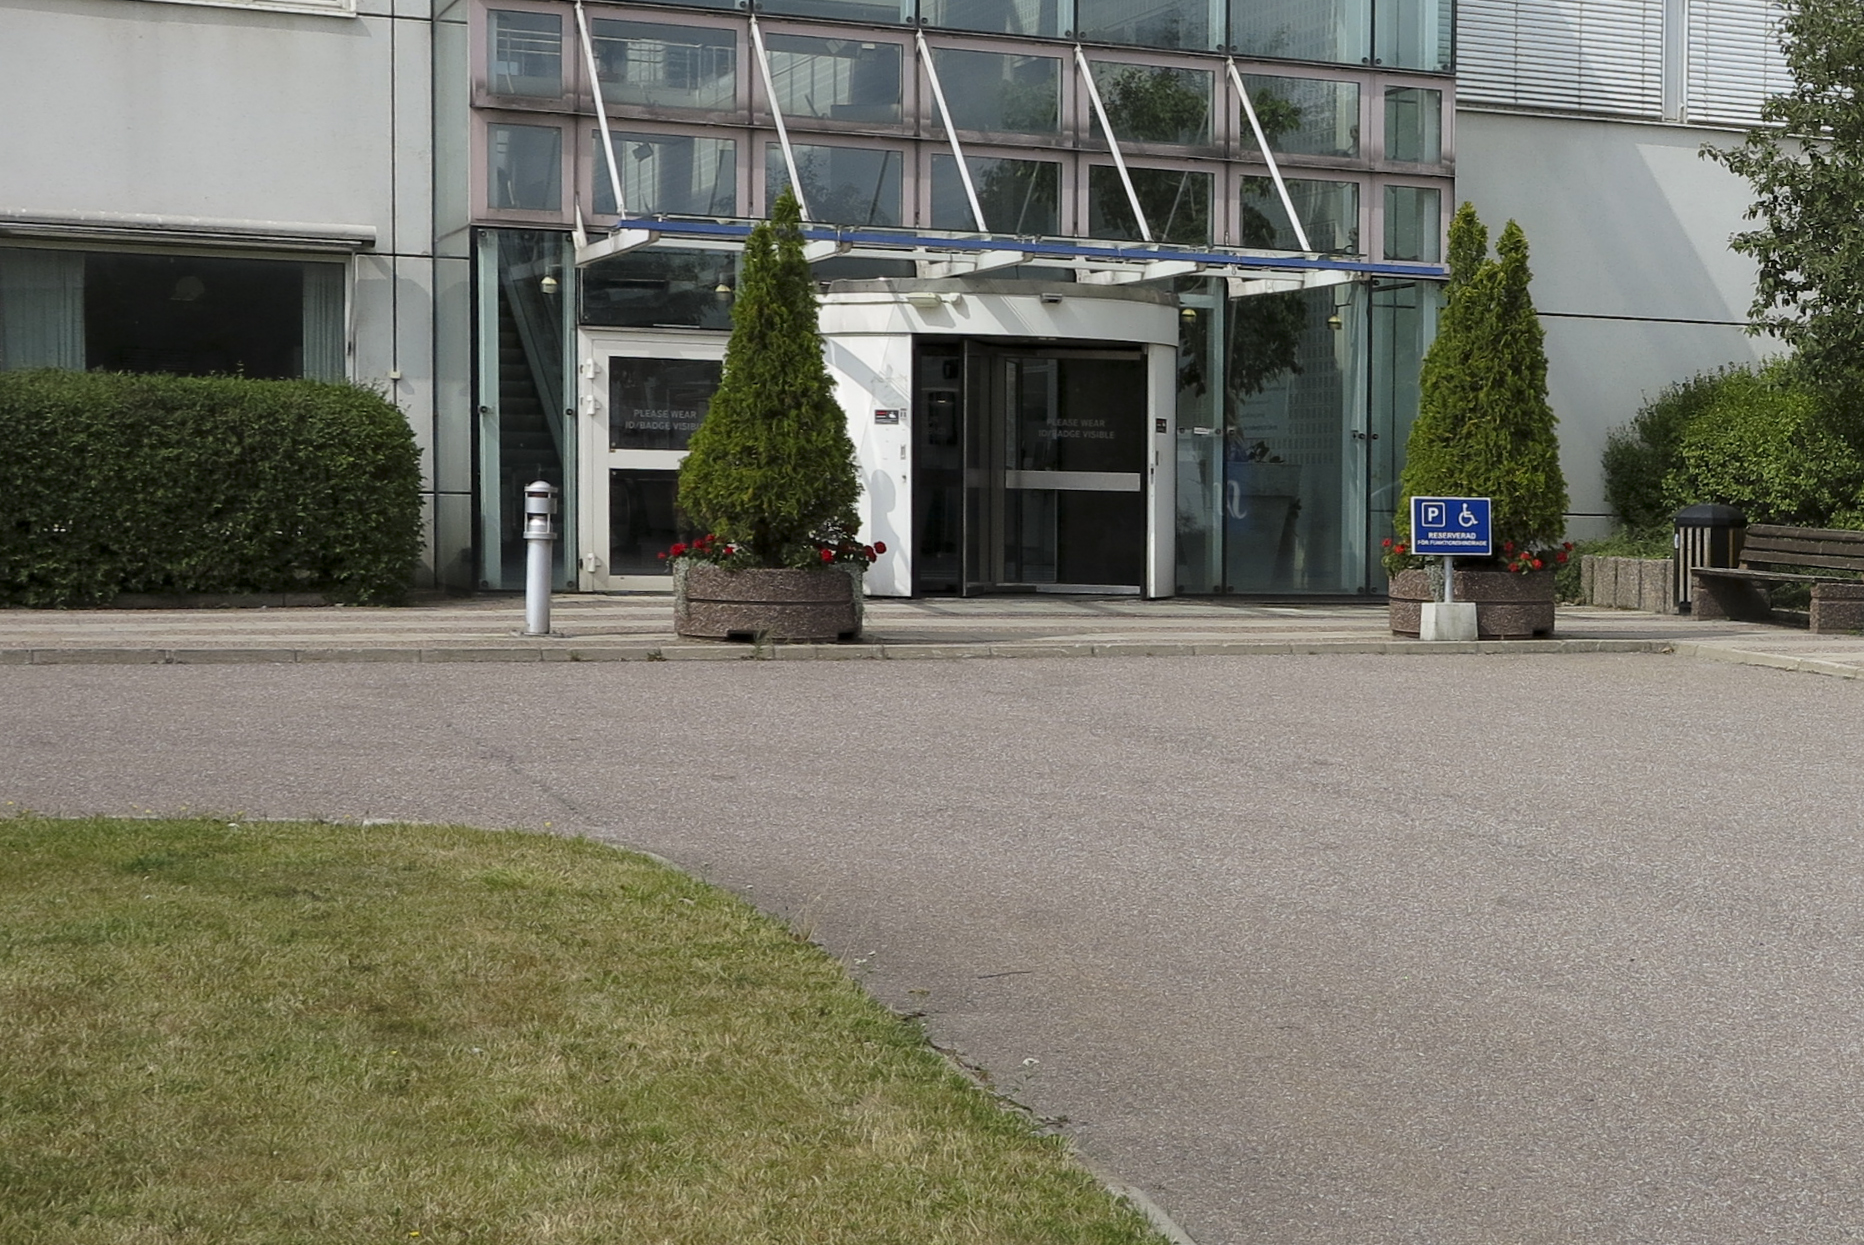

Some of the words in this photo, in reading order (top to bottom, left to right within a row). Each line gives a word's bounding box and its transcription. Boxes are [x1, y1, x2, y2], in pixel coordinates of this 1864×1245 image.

[633, 409, 669, 418] PLEASE
[671, 410, 697, 419] WEAR
[625, 421, 670, 430] ID/BADGE
[672, 422, 702, 431] VISIB
[1046, 418, 1079, 427] PLEASE
[1081, 419, 1106, 428] WEAR
[1038, 429, 1080, 438] ID/BADGE
[1083, 430, 1115, 439] VISIBLE
[1427, 507, 1439, 522] P
[1427, 532, 1477, 540] RESERVERAD
